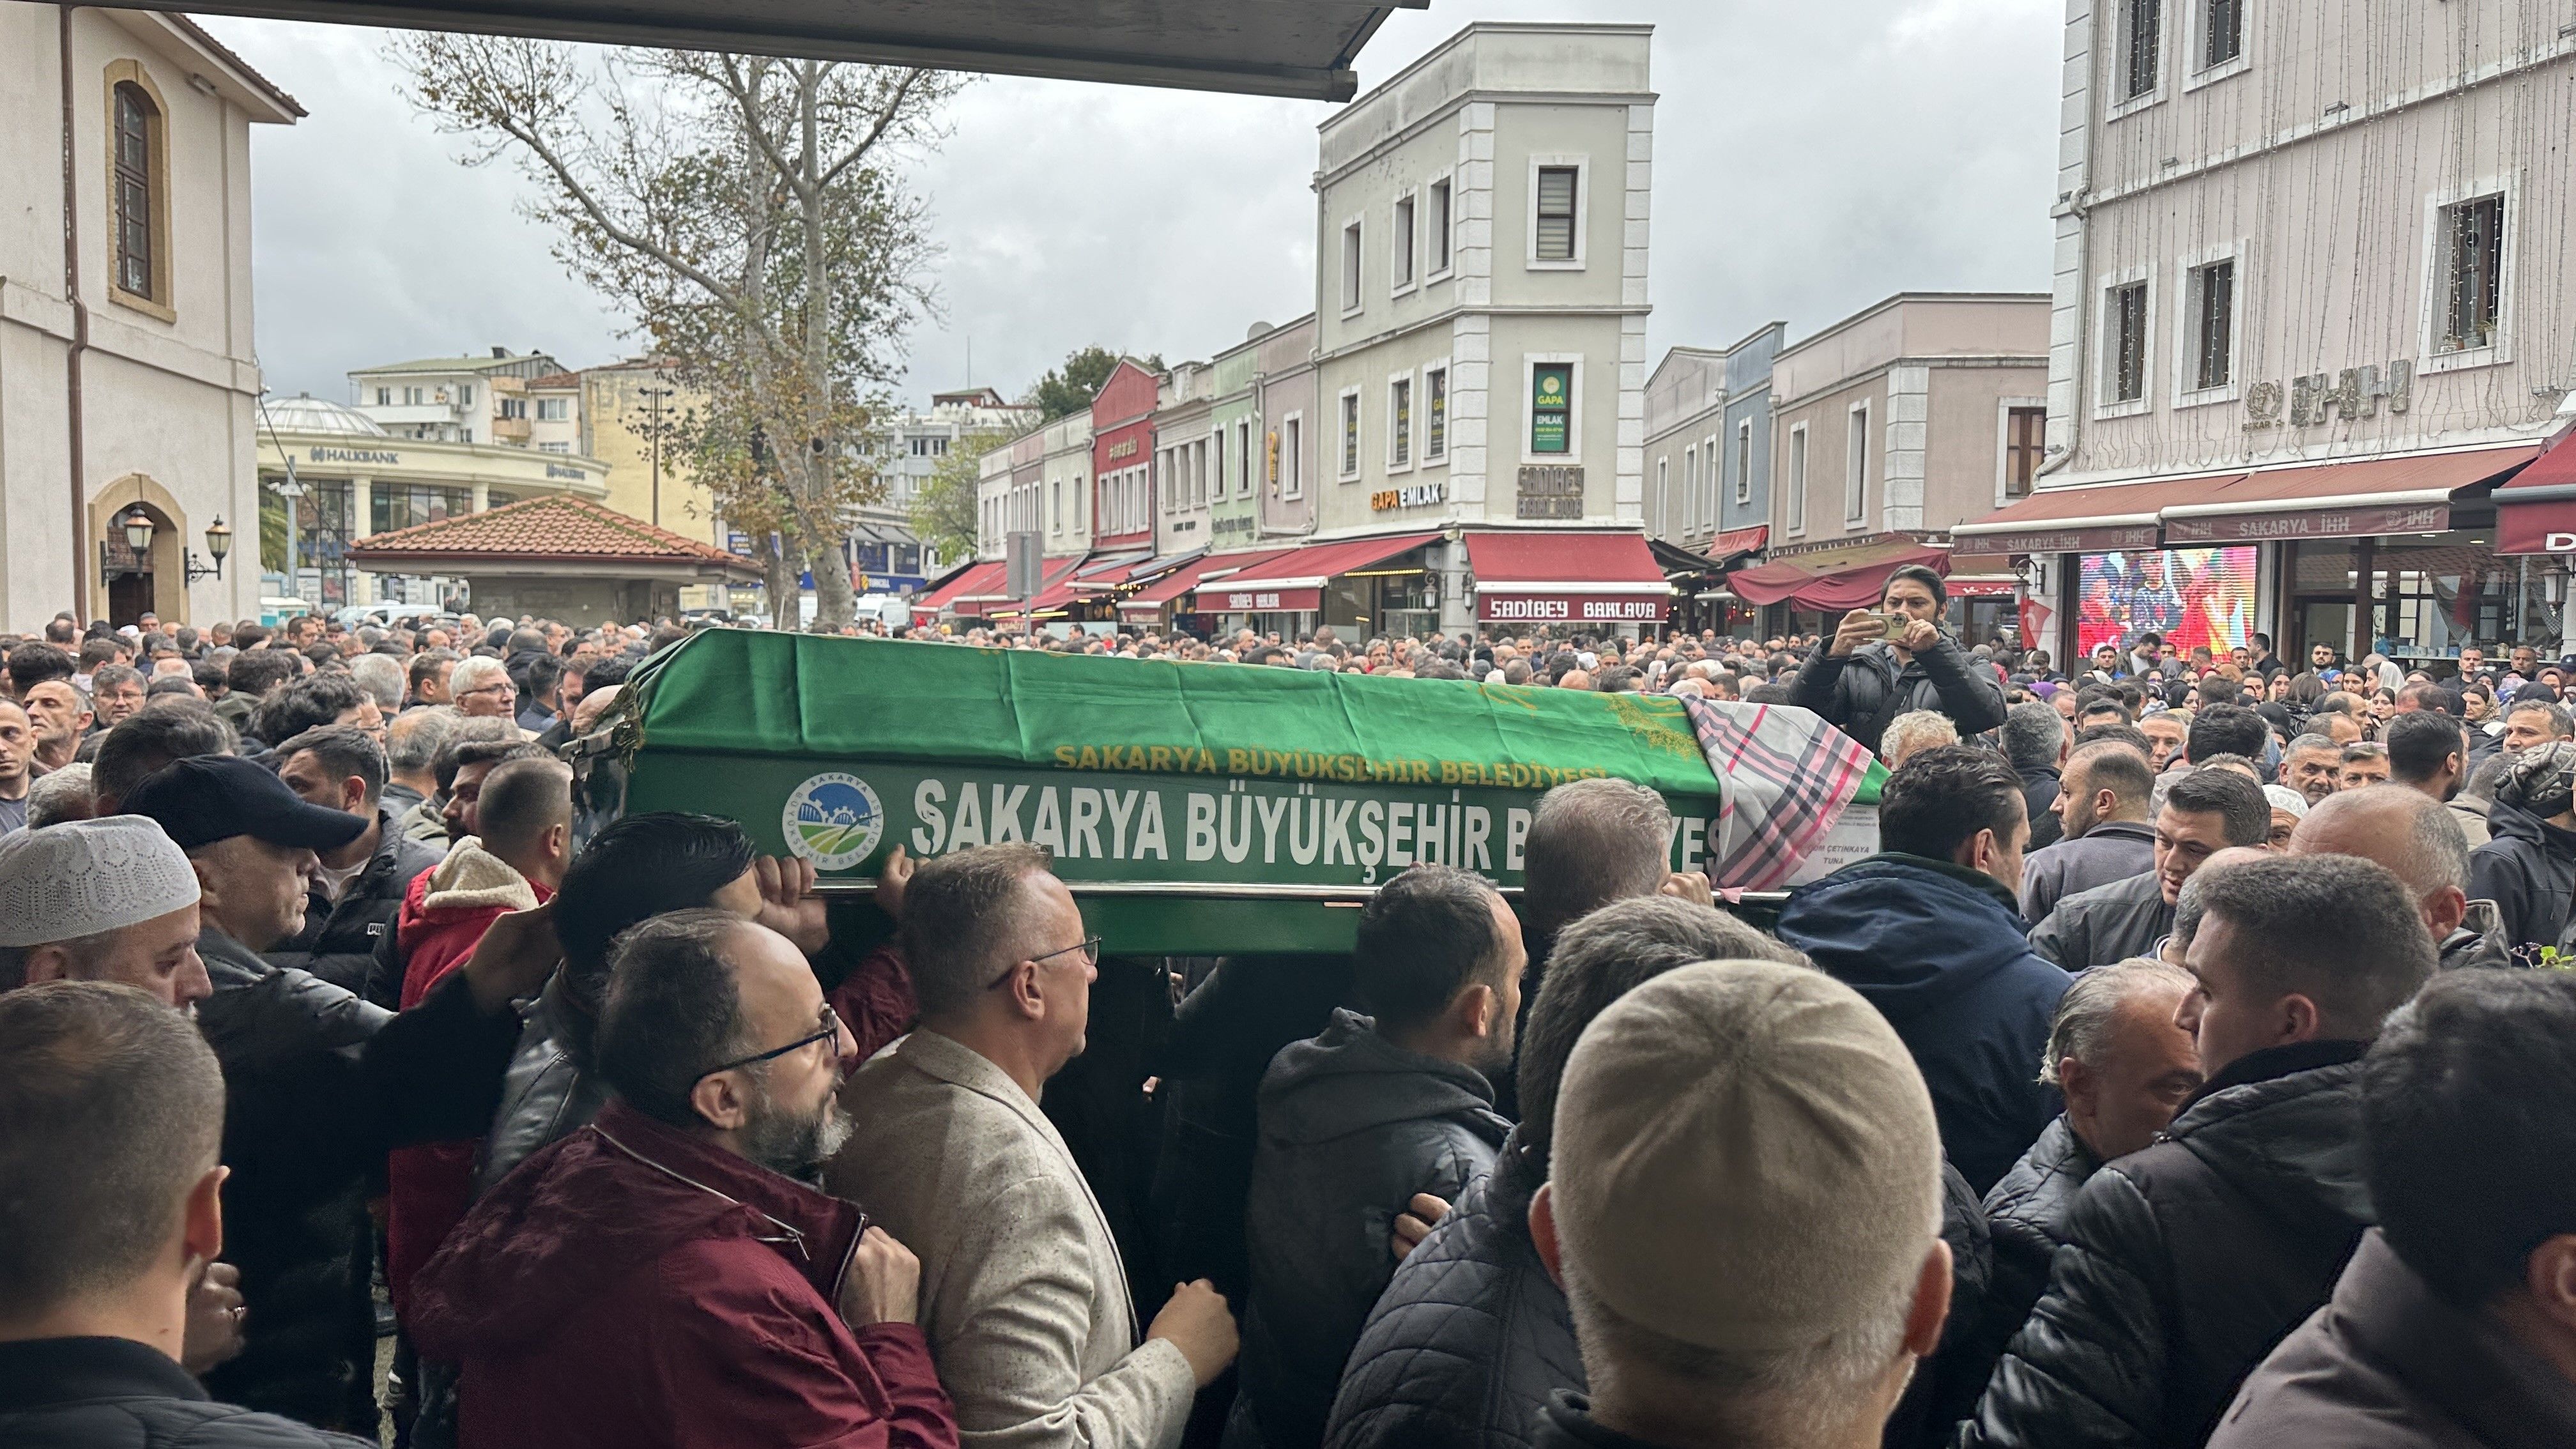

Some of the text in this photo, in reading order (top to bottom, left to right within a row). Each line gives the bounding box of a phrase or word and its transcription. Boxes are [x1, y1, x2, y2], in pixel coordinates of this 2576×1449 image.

[1537, 395, 1563, 404] GAPA
[1536, 413, 1564, 425] EMLAK
[326, 448, 399, 464] HALKBANK
[1370, 482, 1442, 511] GAPA EMLAK
[2239, 517, 2309, 537] SAKARYA
[2320, 514, 2350, 533] İHH
[2007, 537, 2055, 551] SAKARYA
[1490, 598, 1657, 619] SADİBEY BAKLAVA
[1054, 745, 1218, 774] SAKARYA
[809, 774, 868, 793] SAKARYA
[912, 778, 1169, 861] SAKARYA
[1186, 779, 1492, 885] BÜYÜKŞEHİR
[1827, 845, 1870, 854] ÇETİNKAYA
